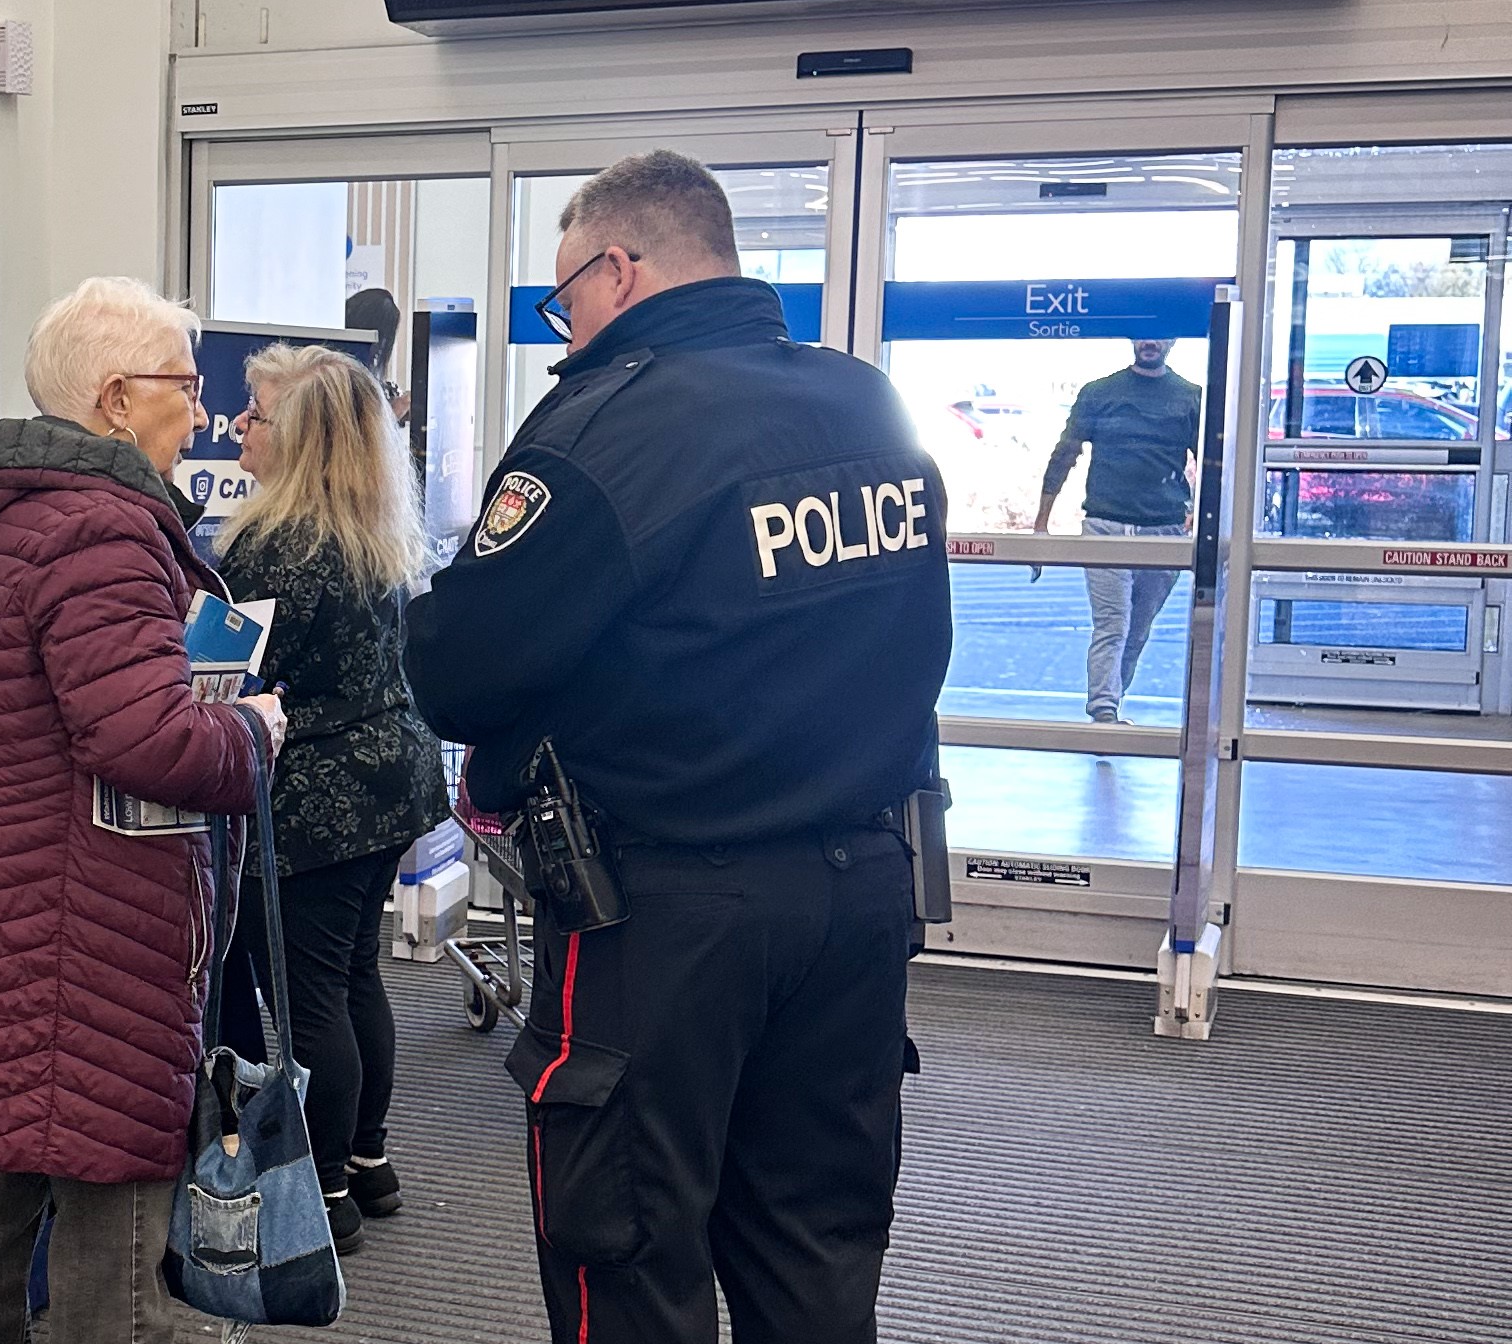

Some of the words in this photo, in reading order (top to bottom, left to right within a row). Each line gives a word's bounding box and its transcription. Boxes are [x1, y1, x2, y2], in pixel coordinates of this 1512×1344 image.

[1024, 284, 1090, 315] Exit
[1028, 321, 1081, 338] Sortie
[219, 478, 256, 499] CA
[503, 476, 543, 504] POLICE
[750, 478, 929, 578] POLICE
[946, 542, 956, 554] SH
[959, 542, 969, 554] TO
[972, 542, 993, 555] OPEN
[1385, 551, 1431, 565] CAUTION
[1435, 553, 1472, 566] STAND
[1476, 554, 1505, 567] BACK
